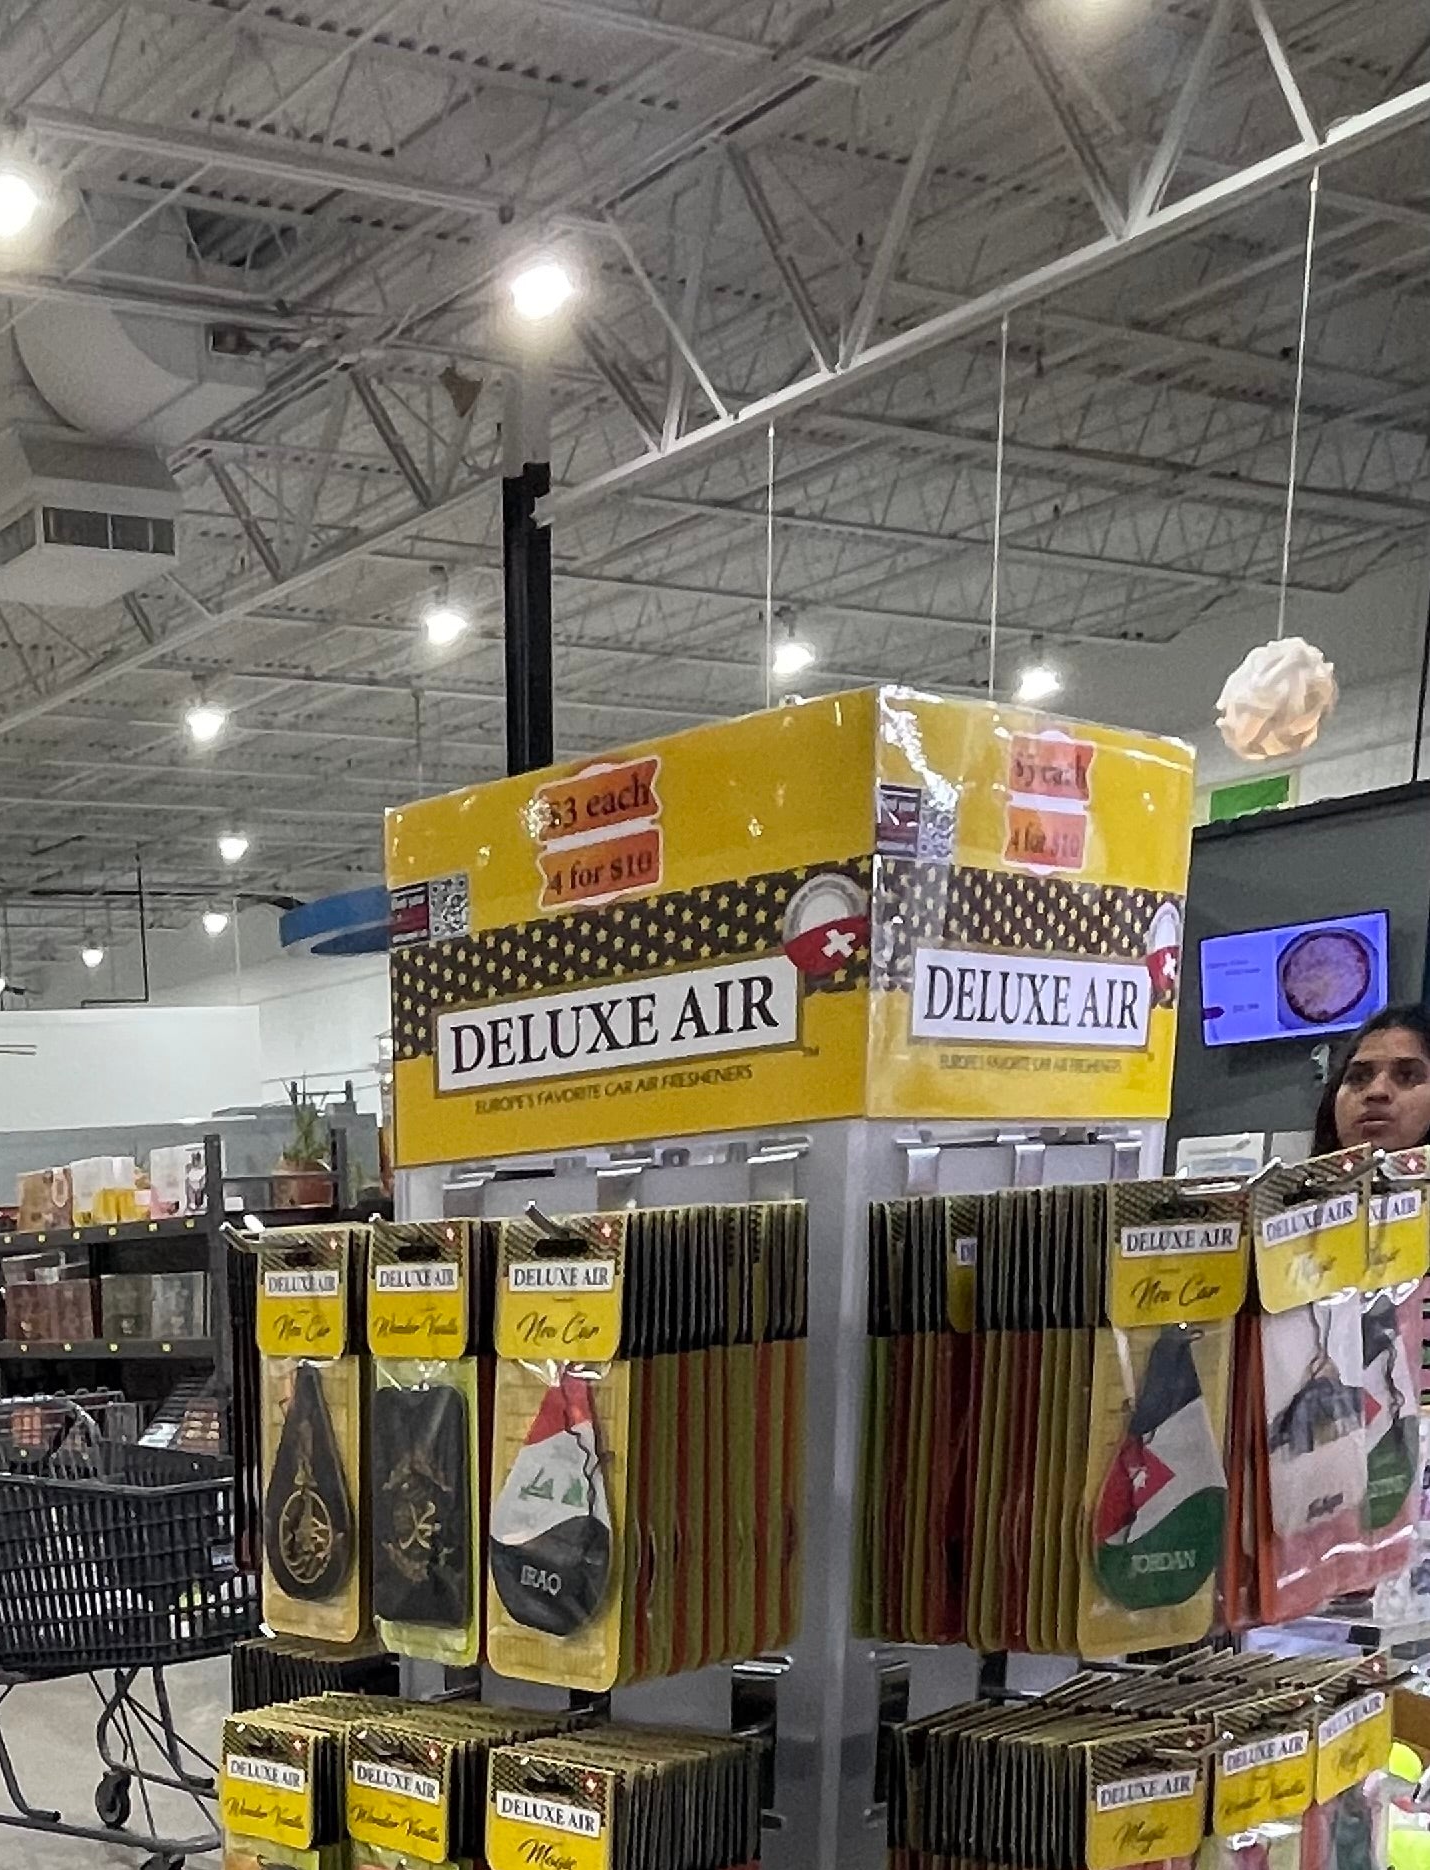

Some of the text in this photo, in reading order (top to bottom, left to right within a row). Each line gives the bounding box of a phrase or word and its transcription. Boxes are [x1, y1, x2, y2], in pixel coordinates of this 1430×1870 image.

[585, 772, 650, 824] each
[549, 854, 653, 895] 4 for $10
[923, 963, 1140, 1031] DELUXE AIR
[450, 974, 781, 1075] DELUXE AIR
[474, 1063, 754, 1116] EUROPE'S FAVORITE CAR AIR FRESHENERS
[1321, 1199, 1355, 1223] AIR
[1126, 1227, 1234, 1253] DELUXE AIR
[311, 1275, 336, 1292] AIR
[378, 1267, 455, 1290] DELUXE AIR
[512, 1265, 610, 1289] DELUXE AIR
[1131, 1277, 1221, 1310] New Car
[273, 1313, 331, 1342] New Car
[516, 1311, 601, 1345] New Car
[1131, 1549, 1197, 1576] JORDAN
[1226, 1744, 1274, 1772] DELUXE
[1276, 1736, 1306, 1757] AIR
[230, 1759, 301, 1788] DELUXE AIR
[355, 1765, 437, 1800] DELUXE AIR
[1100, 1776, 1191, 1808] DELUXE AIR
[500, 1796, 596, 1834] DELUXE AIR
